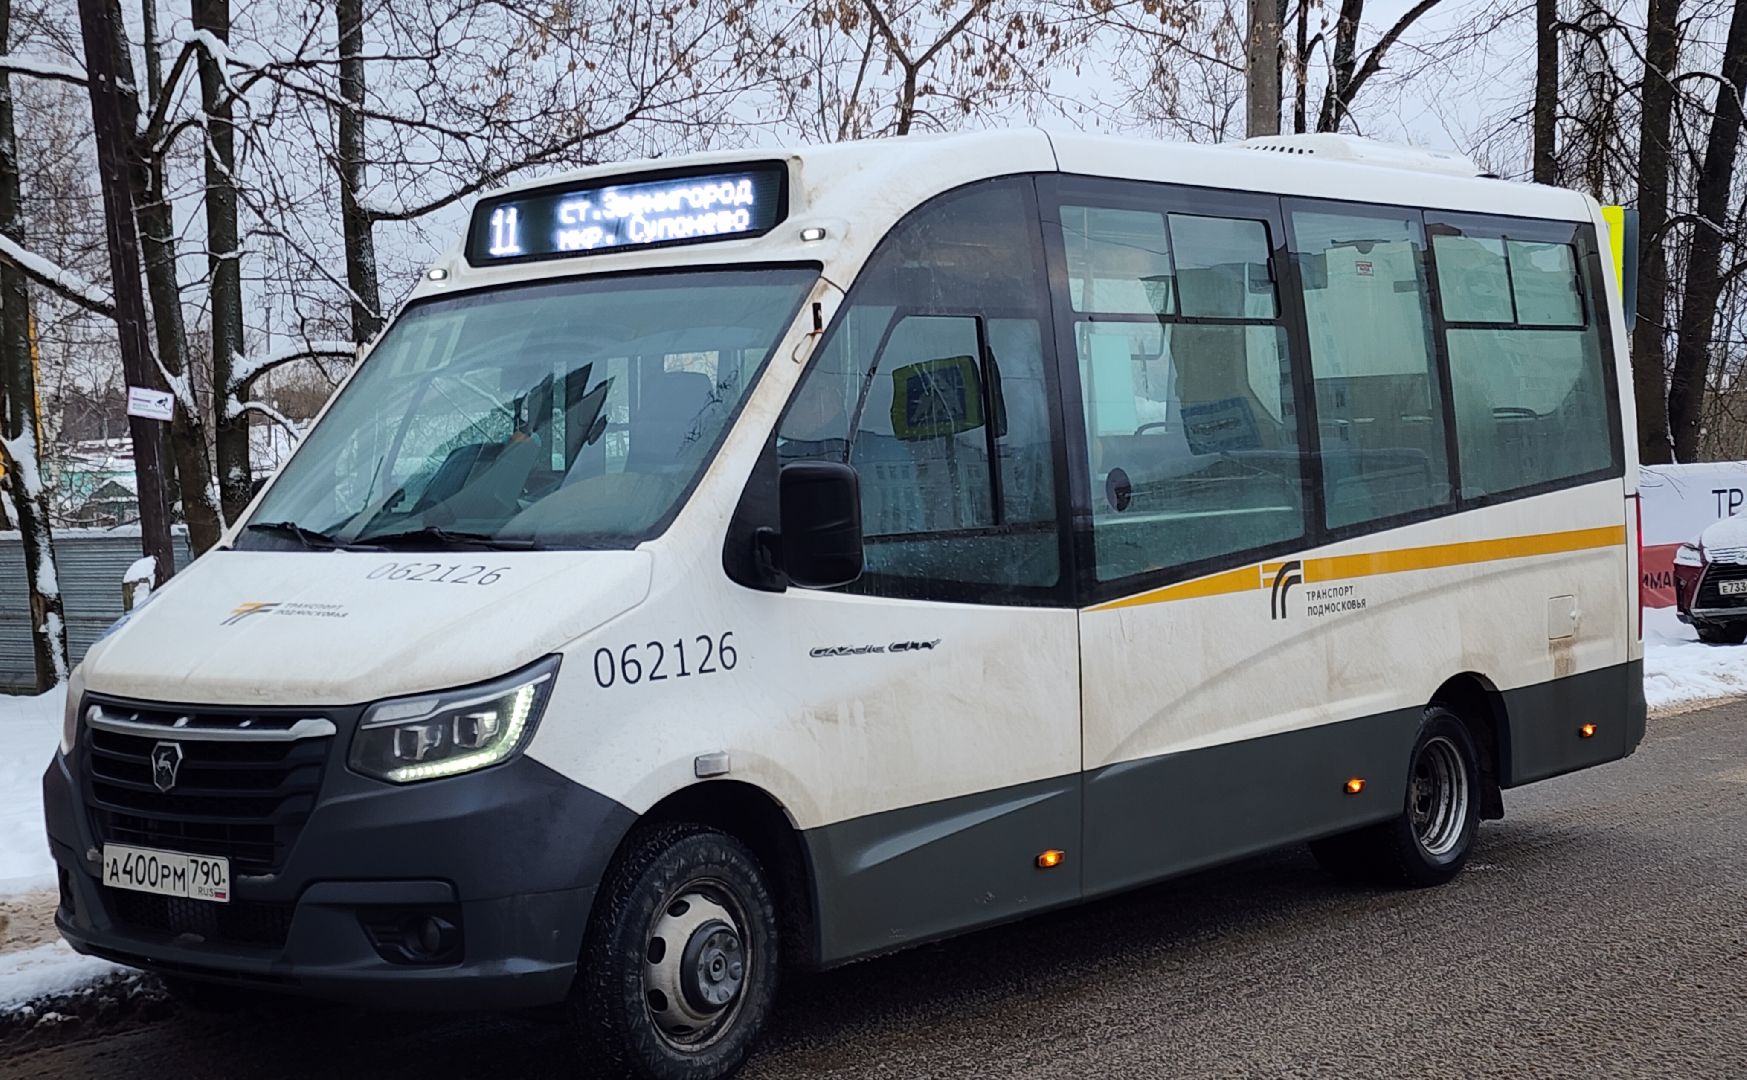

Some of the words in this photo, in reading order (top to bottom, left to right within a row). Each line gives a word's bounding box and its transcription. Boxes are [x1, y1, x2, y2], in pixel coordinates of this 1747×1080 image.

[489, 207, 521, 256] 11
[366, 562, 511, 586] 062126
[1306, 585, 1354, 602] ТРАНСПОРТ
[1307, 598, 1367, 617] ПОДМОСКОВЬЯ
[593, 631, 737, 688] 062126
[189, 859, 221, 886] 790
[197, 886, 214, 898] RUS
